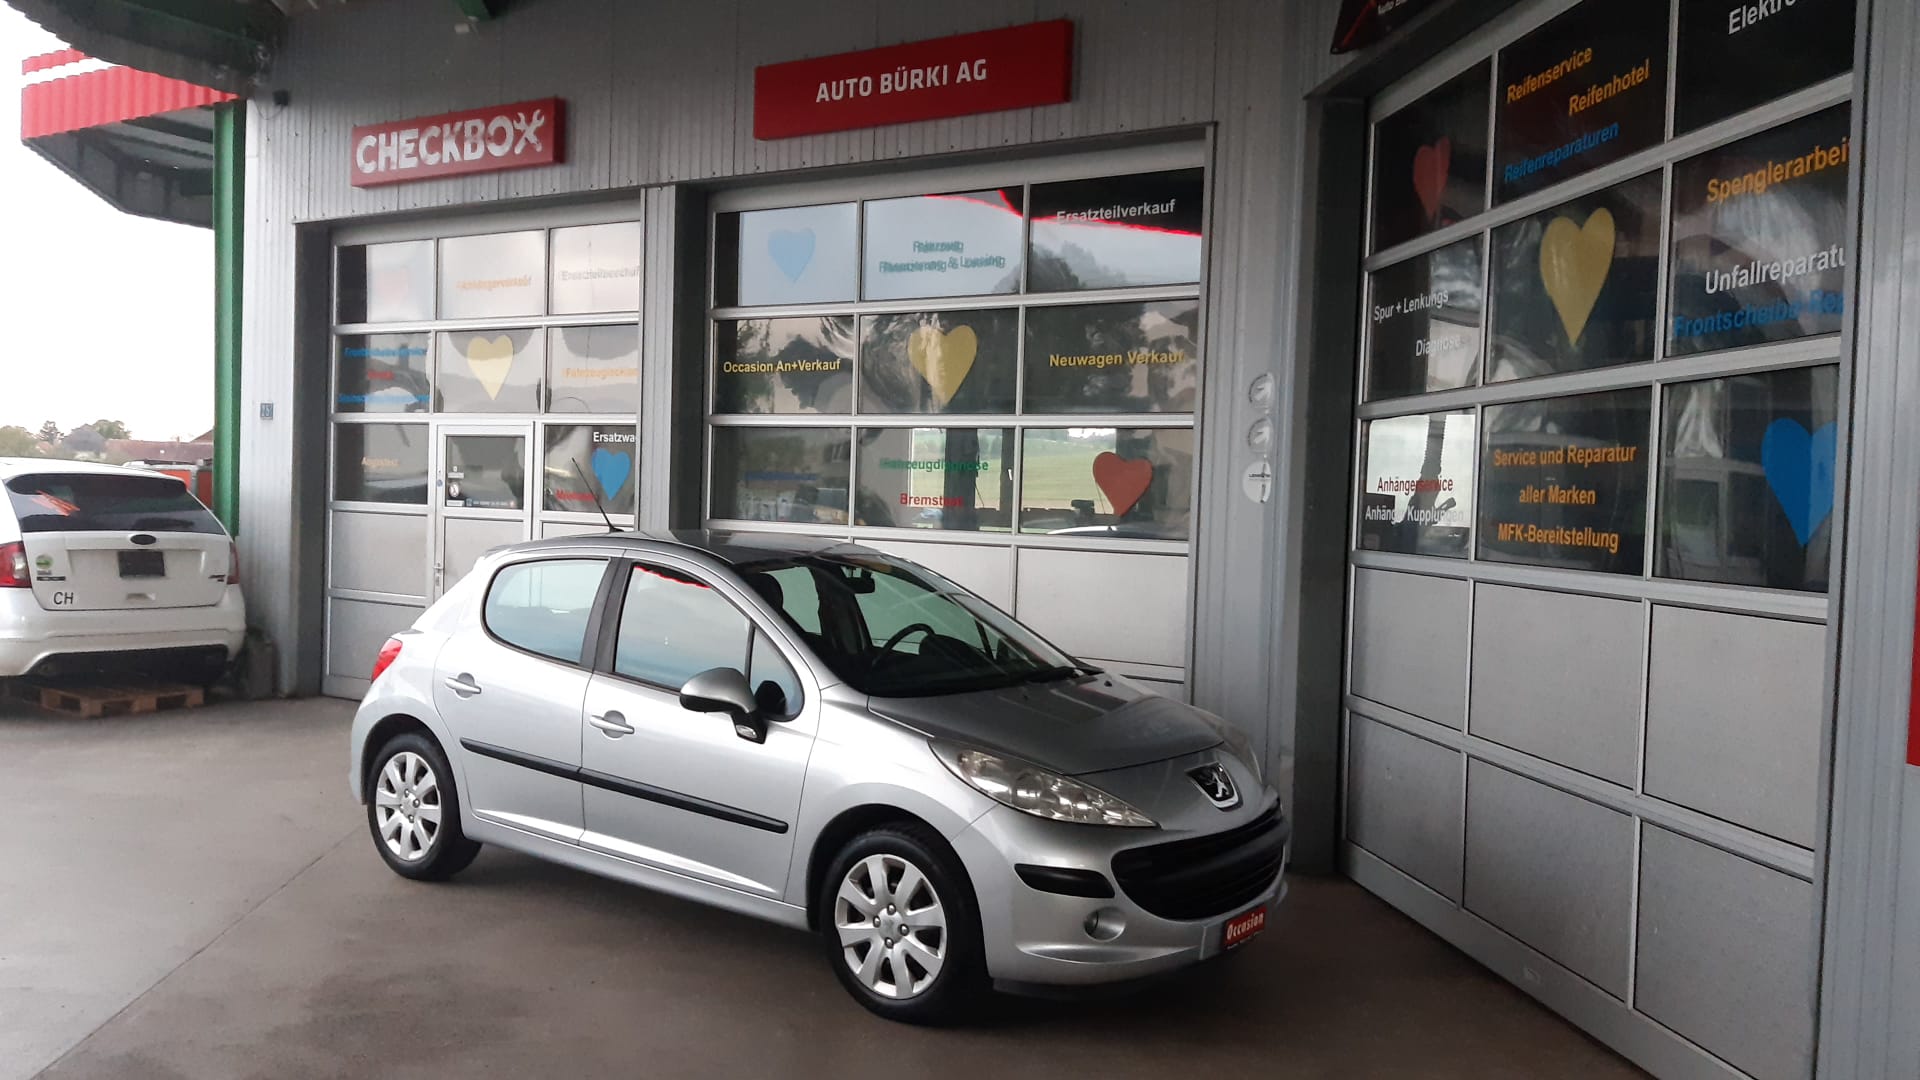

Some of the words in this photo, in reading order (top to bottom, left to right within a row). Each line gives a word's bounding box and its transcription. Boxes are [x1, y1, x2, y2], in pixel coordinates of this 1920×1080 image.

[815, 76, 873, 103] AUTO
[879, 65, 949, 95] BÜRKI
[955, 58, 988, 84] AG
[1507, 48, 1592, 103] Reifenservice
[1568, 58, 1650, 116] Reifenhotel
[356, 109, 545, 174] CHECKBOX
[1504, 121, 1620, 183] Reifenreparaturen
[1706, 136, 1850, 203] Spenglerarbei
[1056, 198, 1176, 221] Ersatzteilverkauf
[1374, 304, 1395, 324] Spur
[1403, 288, 1449, 314] Lenkungs
[723, 361, 774, 373] Occasion
[776, 358, 841, 372] An+Verkauf
[1049, 353, 1123, 368] Neuwagen
[1127, 349, 1186, 365] Verkauf
[1495, 447, 1537, 466] Service
[1540, 448, 1564, 465] und
[1567, 443, 1638, 468] Reparatur
[1520, 483, 1546, 504] aller
[1548, 484, 1597, 505] Marken
[1497, 522, 1620, 554] MFK-Bereitstellung
[53, 591, 74, 605] CH
[1227, 912, 1264, 940] Occasion
